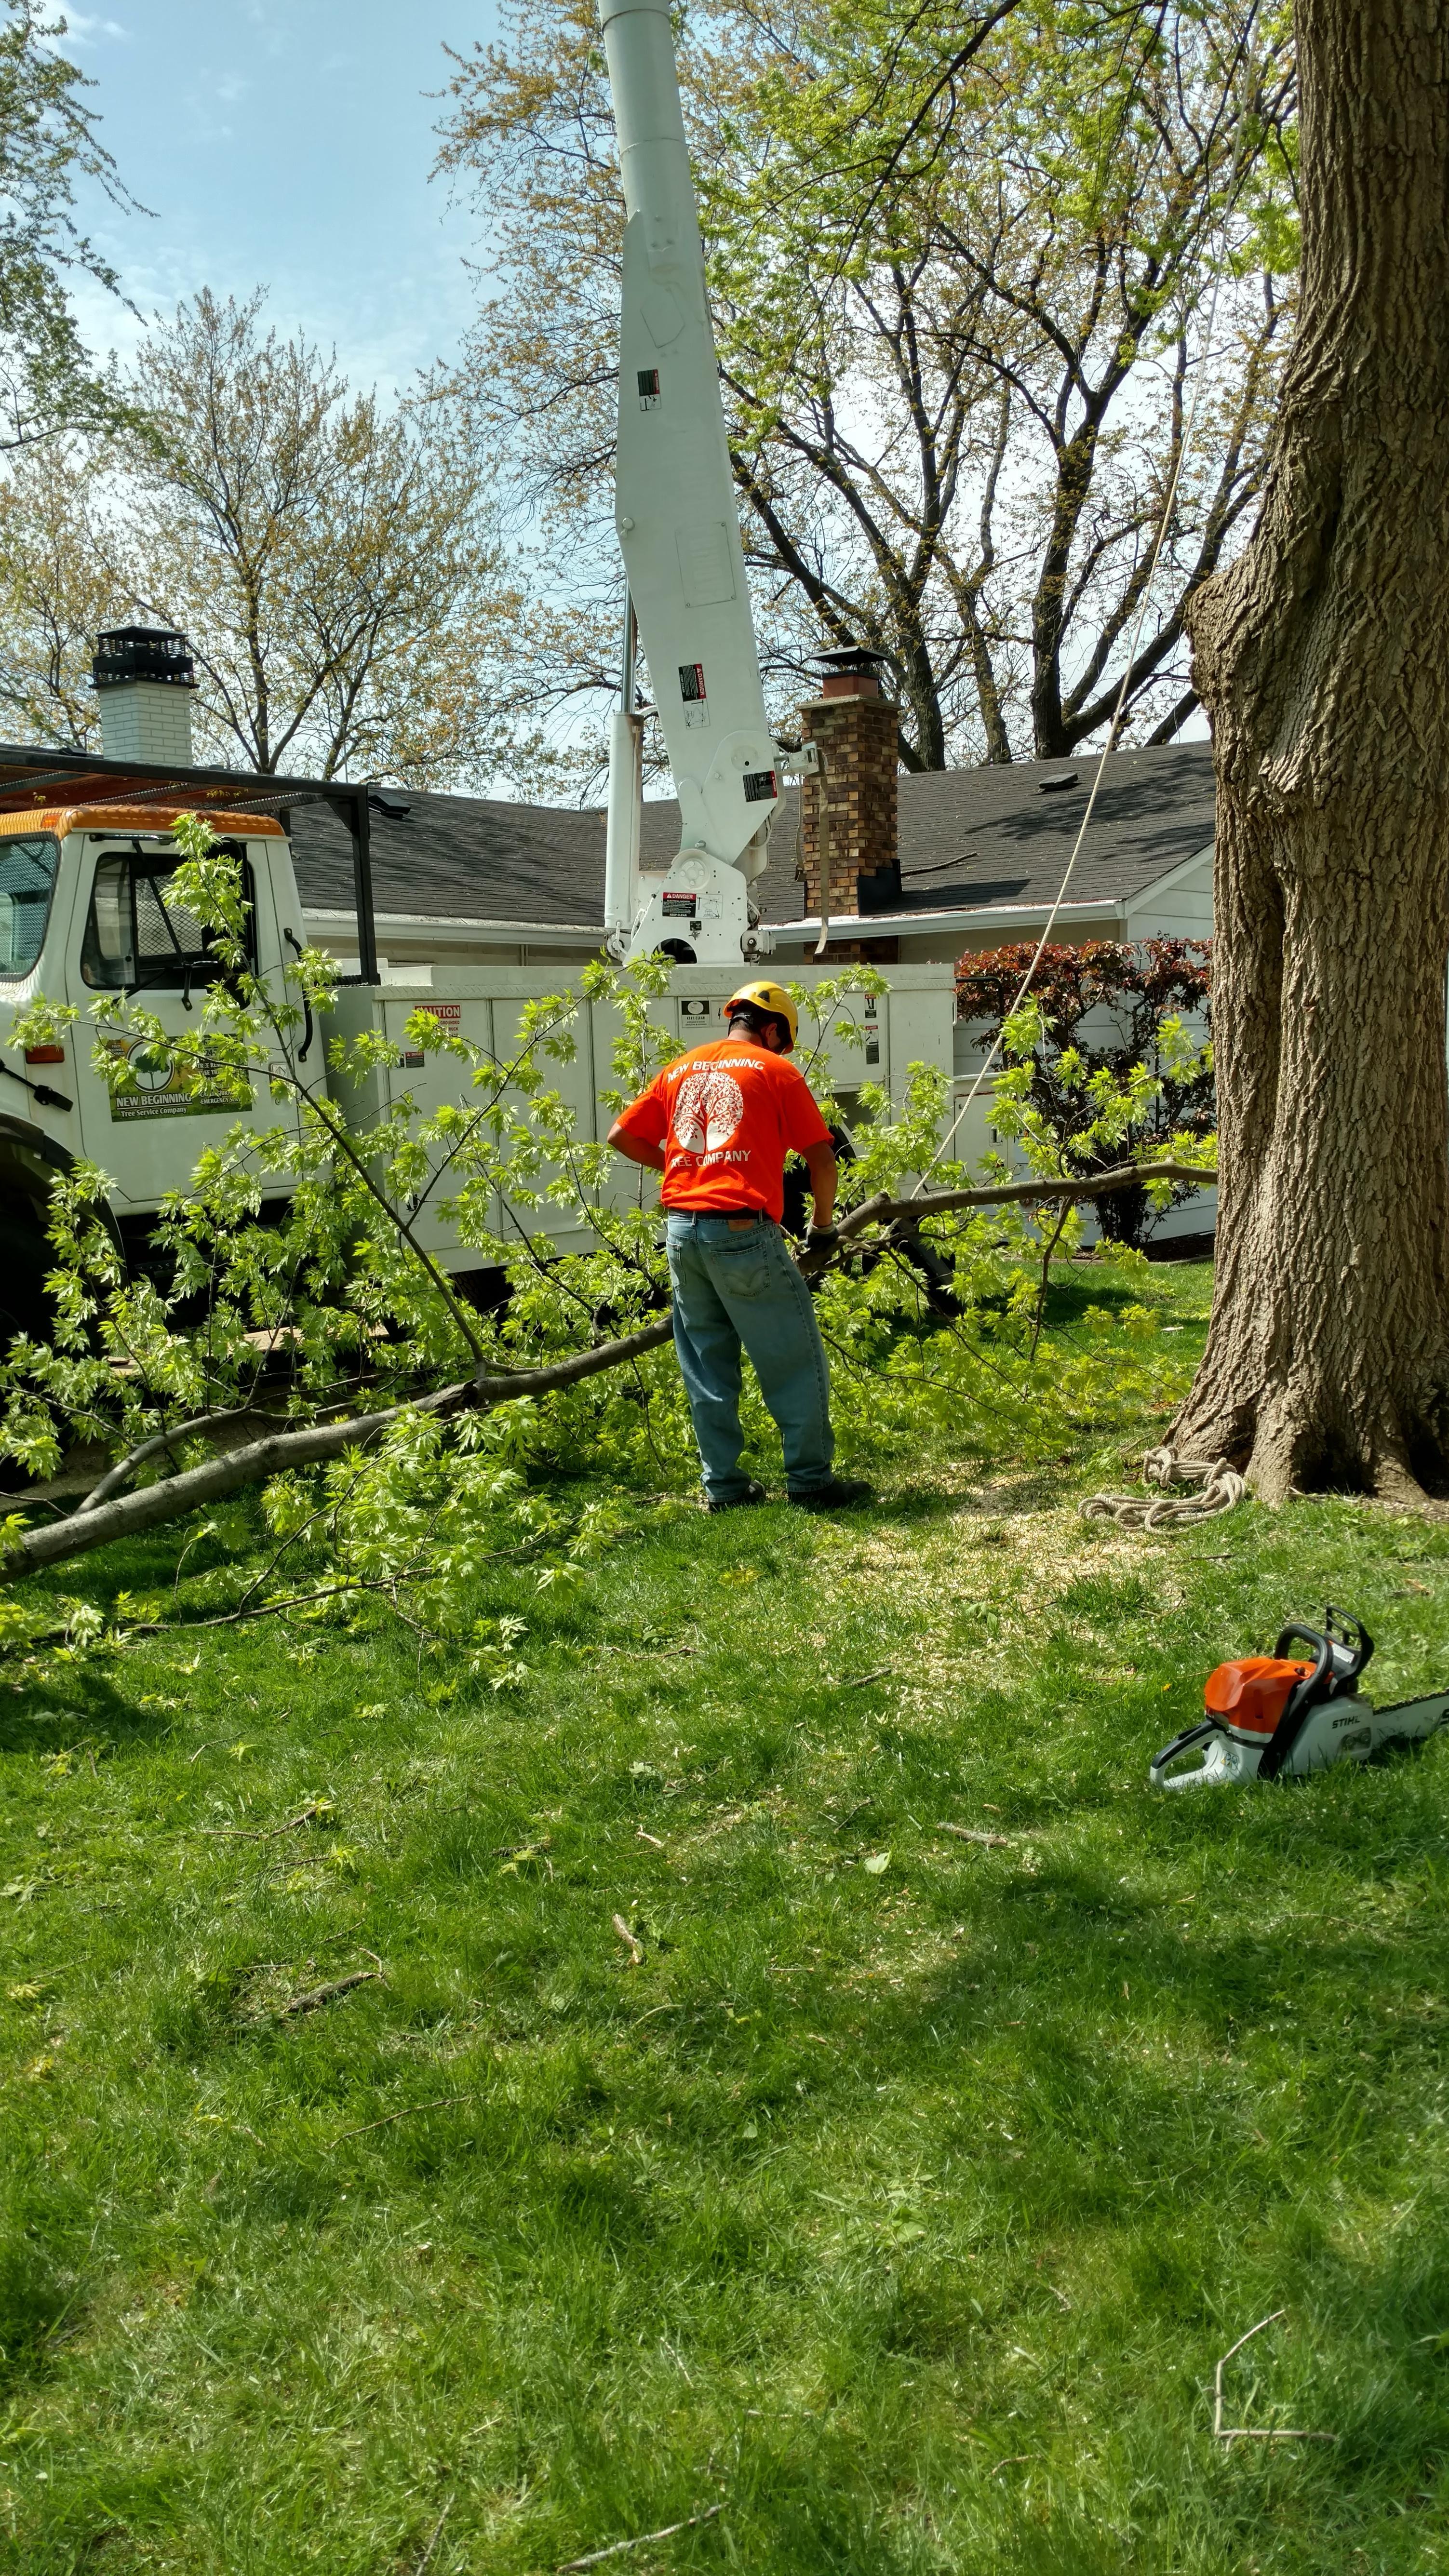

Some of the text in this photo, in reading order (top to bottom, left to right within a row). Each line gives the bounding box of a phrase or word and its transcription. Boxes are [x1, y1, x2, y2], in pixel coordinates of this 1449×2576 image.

[667, 1058, 765, 1084] NEW BEGINNING
[116, 1093, 192, 1107] NEW BEGINNING
[160, 1107, 187, 1115] Company
[696, 1150, 751, 1167] COMPANY
[1332, 1716, 1361, 1729] STIHL
